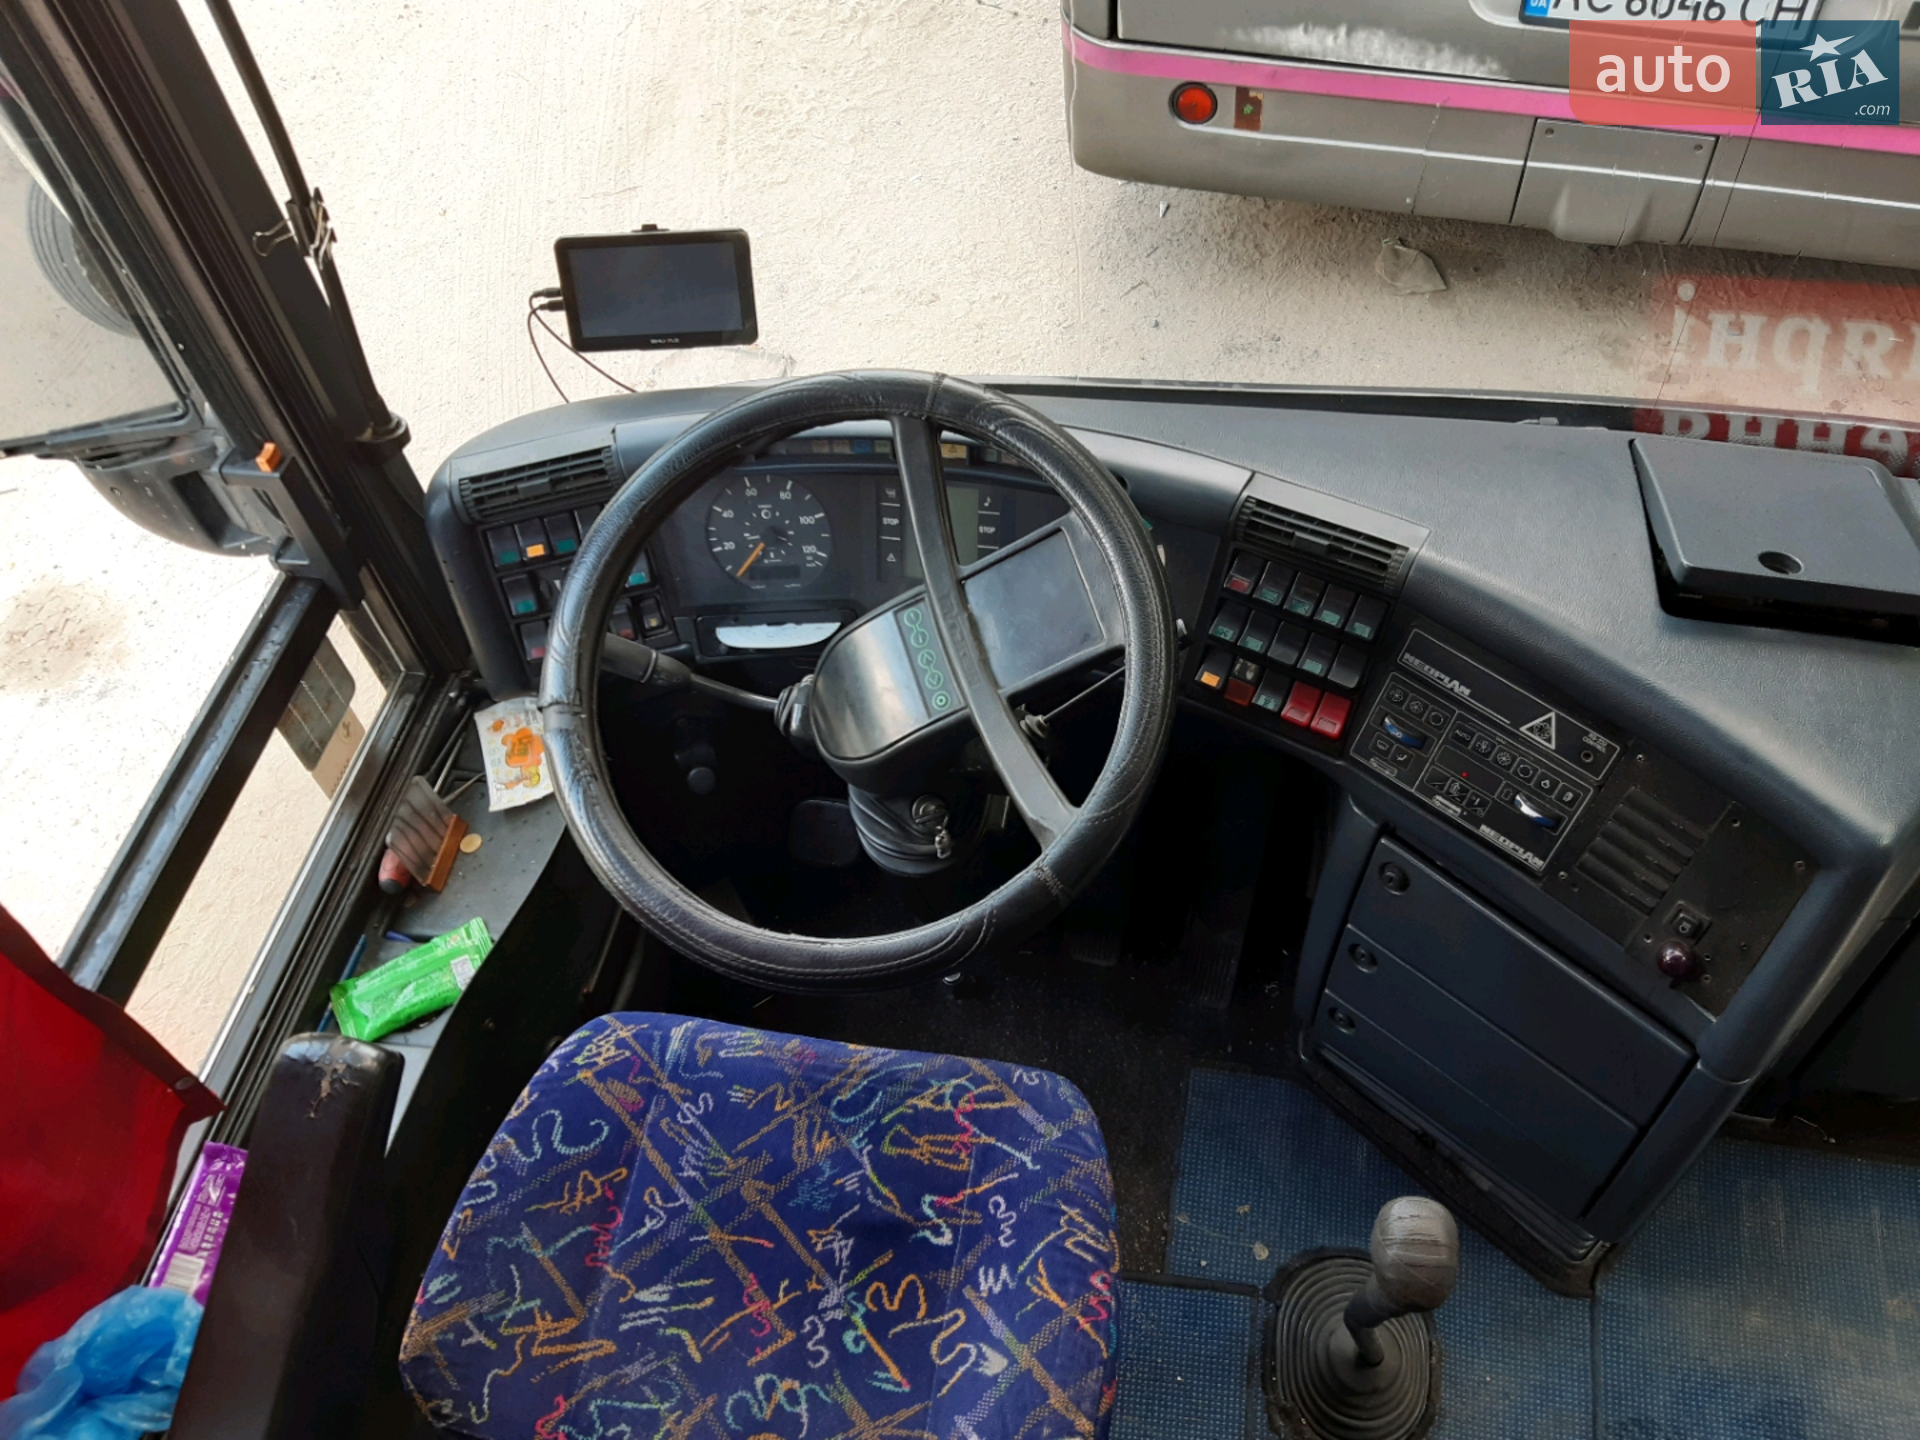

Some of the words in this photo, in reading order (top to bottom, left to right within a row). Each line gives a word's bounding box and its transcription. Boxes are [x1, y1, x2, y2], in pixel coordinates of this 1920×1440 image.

[745, 487, 758, 497] 60
[779, 491, 792, 500] 80
[721, 509, 734, 518] 40
[799, 515, 816, 525] 100
[882, 516, 900, 526] STOP
[978, 525, 996, 534] STOP
[722, 541, 736, 550] 20
[802, 545, 817, 554] 120
[1402, 652, 1472, 697] NEOPLAN
[1455, 729, 1471, 741] AUTO
[1480, 824, 1545, 868] NEOPLAN
